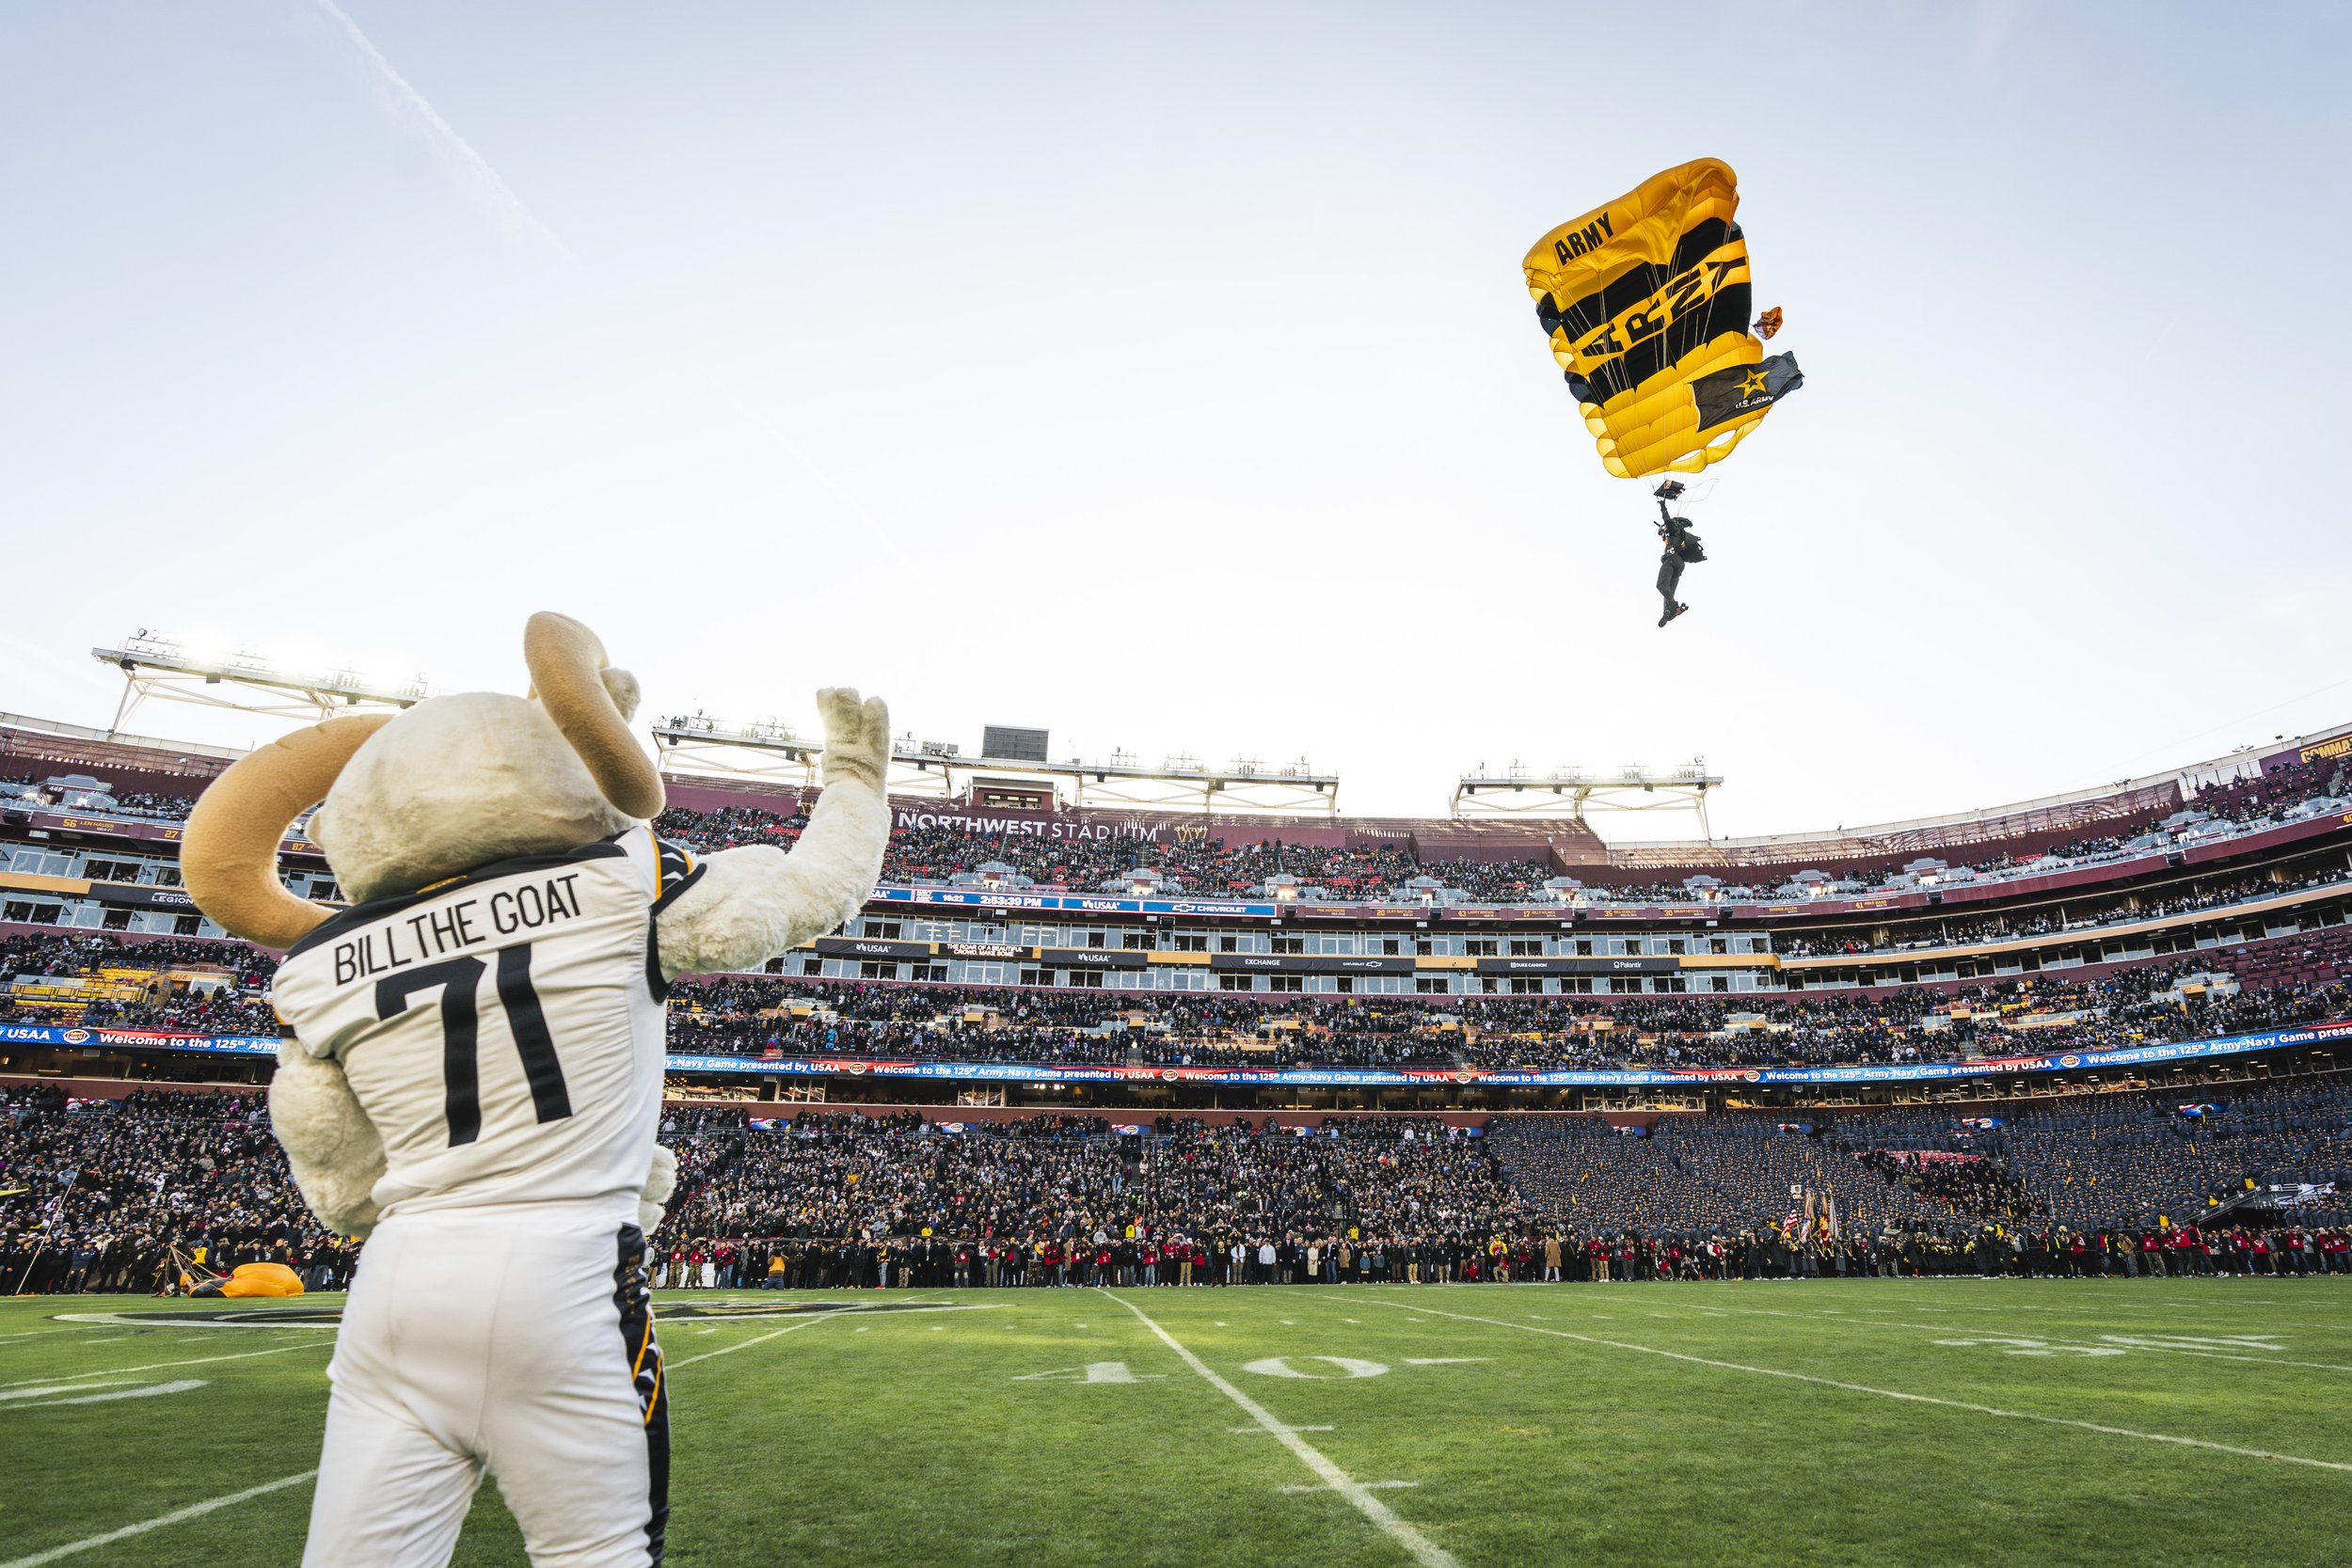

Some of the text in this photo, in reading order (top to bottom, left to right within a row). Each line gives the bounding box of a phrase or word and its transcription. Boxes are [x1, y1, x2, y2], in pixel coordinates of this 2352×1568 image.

[1554, 212, 1614, 266] ARMY
[1735, 396, 1773, 409] U.S. ARMY
[2301, 738, 2352, 764] COMMA
[63, 818, 77, 828] 56
[898, 813, 1157, 842] NORTHWEST STADIUM
[165, 830, 179, 839] 27
[151, 895, 194, 904] LEGION
[1024, 897, 1041, 907] PM
[335, 874, 581, 986] BILL THE GOAT
[8, 1029, 50, 1040] USAA
[100, 1034, 167, 1046] Welcome
[170, 1037, 185, 1047] to
[189, 1037, 212, 1048] the
[216, 1038, 246, 1050] 125th
[375, 942, 573, 1148] 71
[2087, 1053, 2140, 1064] Welcome
[2158, 1049, 2177, 1058] the
[2210, 1036, 2276, 1052] Army-Navy
[2279, 1032, 2314, 1043] Game
[2318, 1026, 2352, 1039] prese
[707, 1060, 736, 1069] Game
[739, 1061, 792, 1071] presented
[795, 1063, 808, 1072] by
[811, 1064, 840, 1072] USAA
[873, 1065, 920, 1074] Welcome
[936, 1067, 951, 1075] the
[978, 1069, 1032, 1078] Army-Navy
[1035, 1069, 1061, 1077] Game
[1064, 1070, 1111, 1080] presented
[1113, 1070, 1125, 1080] by
[1128, 1070, 1154, 1079] USAA
[1766, 1071, 1809, 1080] Welcome
[1823, 1070, 1837, 1079] the
[1864, 1069, 1918, 1078] Army-Navy
[1920, 1067, 1949, 1075] Game
[1951, 1064, 2004, 1075] presented
[2006, 1063, 2018, 1072] by
[2021, 1060, 2053, 1070] USAA
[1184, 1072, 1228, 1081] Welcome
[1230, 1072, 1240, 1081] to
[1242, 1072, 1257, 1081] the
[1281, 1072, 1332, 1082] Army-Navy
[1335, 1072, 1359, 1081] Game
[1363, 1073, 1407, 1083] presented
[1409, 1073, 1421, 1083] by
[1422, 1073, 1449, 1082] USAA
[1478, 1073, 1518, 1082] Welcome
[1533, 1073, 1548, 1082] the
[1572, 1073, 1621, 1083] Army-Navy
[1651, 1073, 1695, 1083] presented
[1697, 1073, 1709, 1082] by
[1711, 1072, 1738, 1081] USAA
